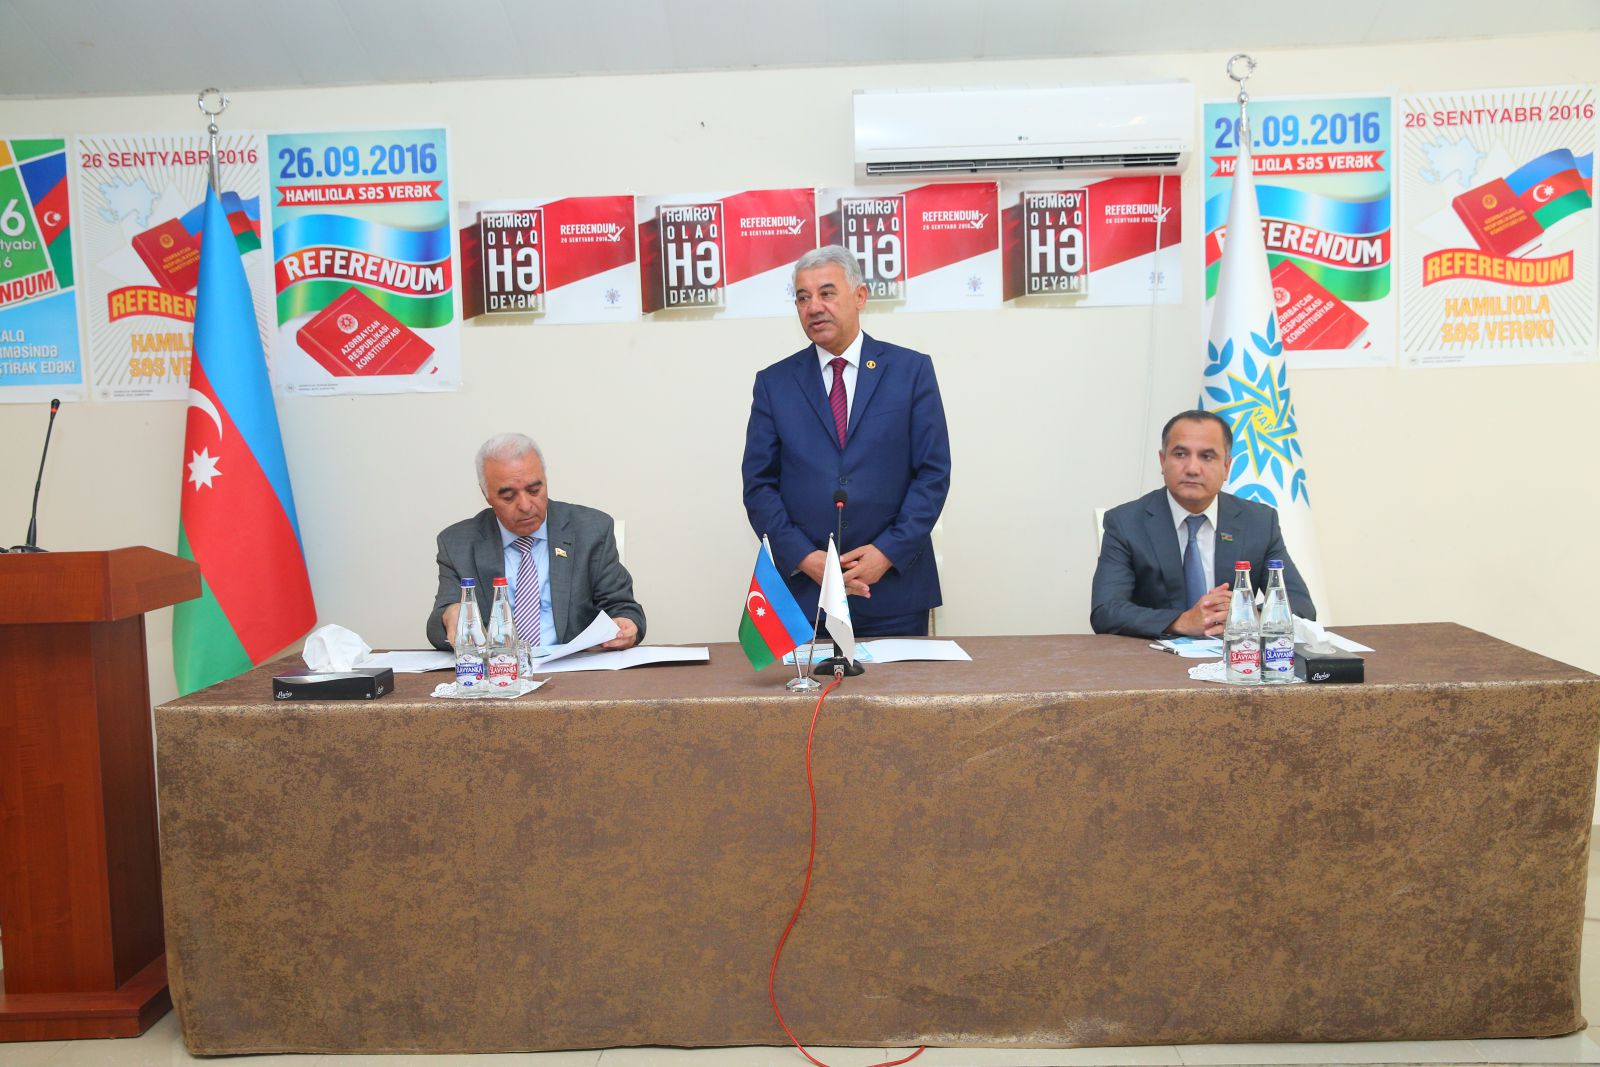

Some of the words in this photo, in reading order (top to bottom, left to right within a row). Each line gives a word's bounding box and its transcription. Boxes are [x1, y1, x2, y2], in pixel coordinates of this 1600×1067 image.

[1405, 112, 1426, 128] 26
[1433, 106, 1542, 127] SENTYABR
[1550, 104, 1594, 121] 2016
[82, 153, 102, 168] 26
[108, 150, 210, 168] SENTYABR
[217, 149, 257, 165] 2016
[278, 143, 437, 179] 26.09.2016
[1220, 157, 1293, 173] HAILIQLA
[1297, 156, 1324, 171] SƏS
[1328, 154, 1374, 169] VERƏK
[285, 187, 355, 203] HAMILIQLA
[358, 186, 385, 200] SƏS
[388, 184, 433, 199] VERƏK
[1030, 192, 1082, 209] HƏMRƏY
[667, 206, 718, 223] HƏMRƏY
[847, 199, 899, 216] HƏMRƏY
[922, 210, 979, 222] REFERENDUM
[0, 198, 26, 237] 6
[487, 212, 538, 229] HƏMRƏY
[740, 216, 797, 228] REFERENDUM
[848, 216, 900, 233] OLAQ
[1030, 210, 1083, 227] OLAQ
[487, 230, 538, 246] OLAQ
[560, 223, 616, 235] REFERENDUM
[667, 224, 718, 240] OLAQ
[1030, 227, 1084, 273] HƏ
[1214, 221, 1383, 265] RERENDUM
[667, 240, 721, 287] HƏ
[848, 233, 902, 280] HƏ
[283, 250, 445, 292] REFERENDUM
[487, 246, 541, 293] HƏ
[1427, 251, 1569, 283] REFERENDUM
[1032, 275, 1079, 291] DEYƏK
[490, 294, 536, 310] DEYƏK
[670, 288, 717, 304] DEYƏK
[1444, 294, 1551, 318] HAMILIQLA
[0, 329, 25, 343] ALQ
[340, 320, 381, 356] AZƏRBAYCAN
[1441, 321, 1480, 343] SƏS
[347, 324, 390, 363] RESPUBLİKASI
[355, 327, 401, 370] KONSTİTUSİYASI
[129, 357, 166, 377] SƏS
